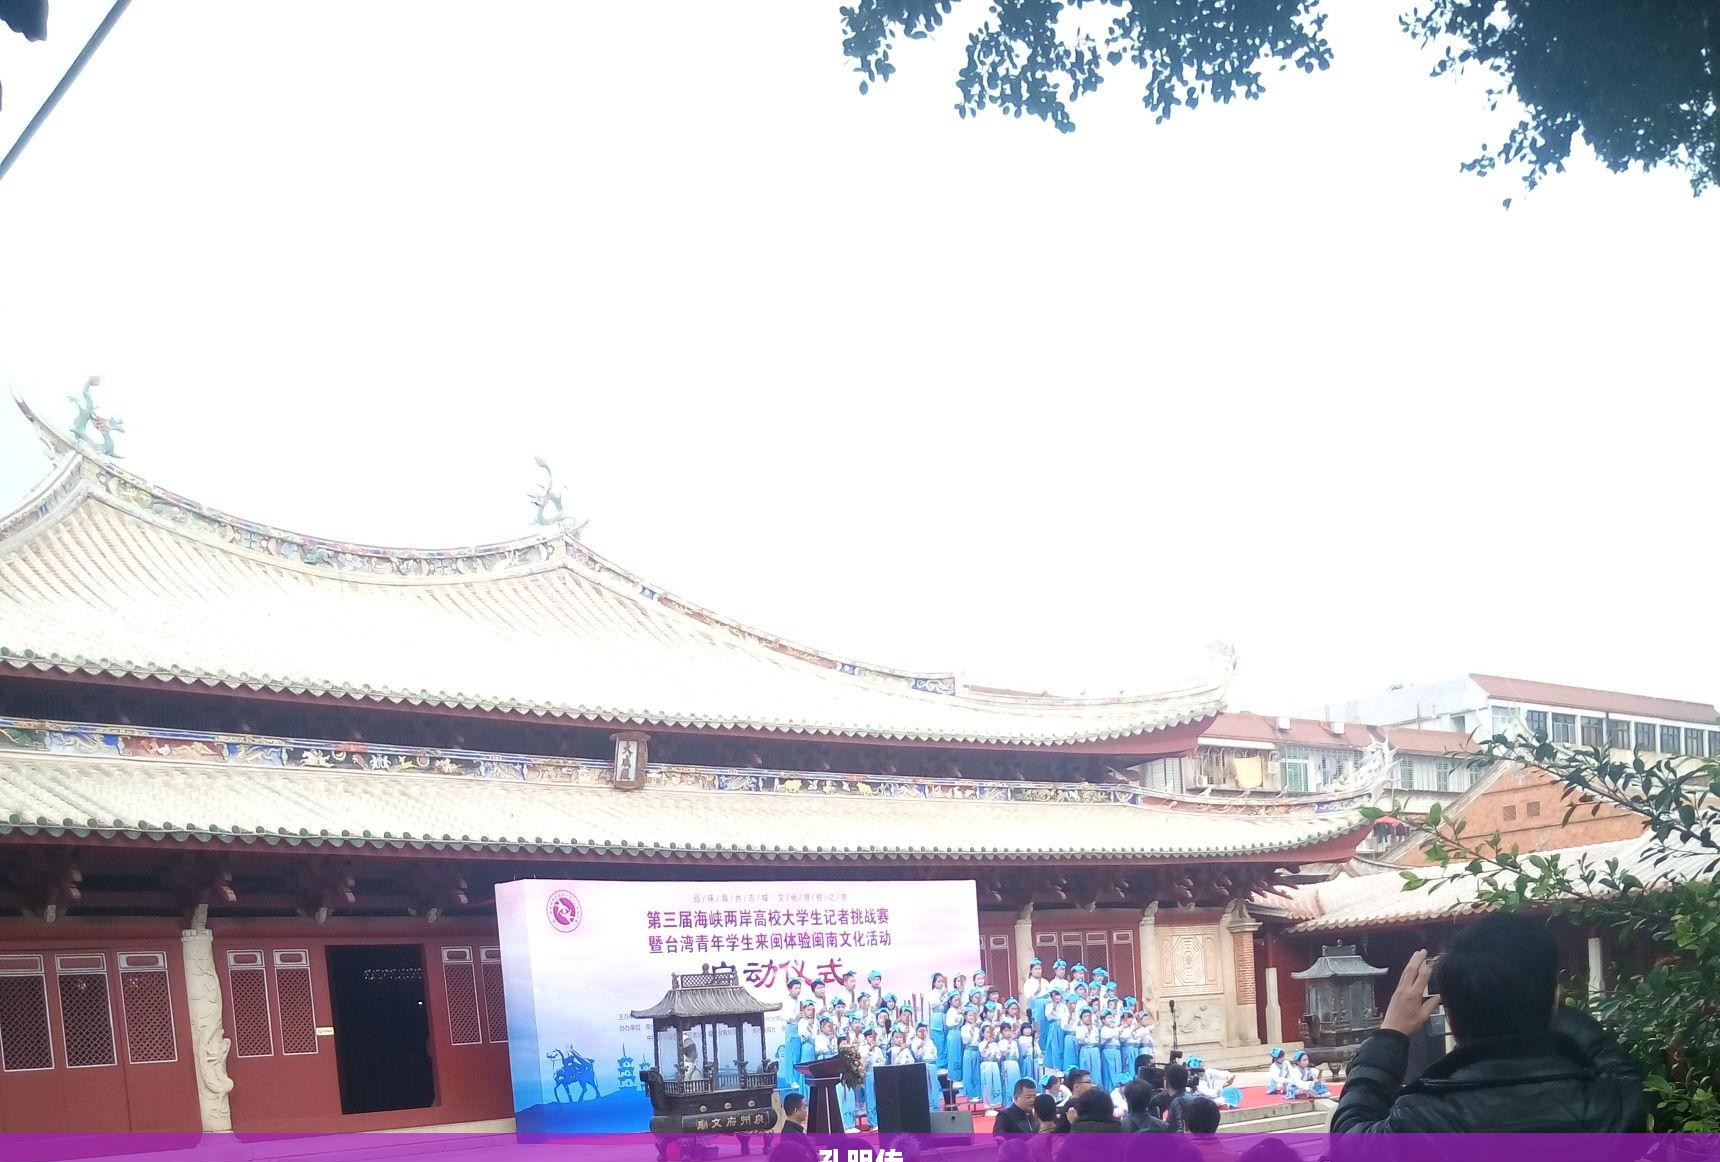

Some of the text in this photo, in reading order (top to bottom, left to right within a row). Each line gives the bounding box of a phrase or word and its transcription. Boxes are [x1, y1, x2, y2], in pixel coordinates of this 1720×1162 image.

[647, 907, 890, 930] 第三届海峡两岸高校大学生记者挑战赛
[649, 929, 892, 955] 暨台湾青年学生来闽体验闽南文化活动
